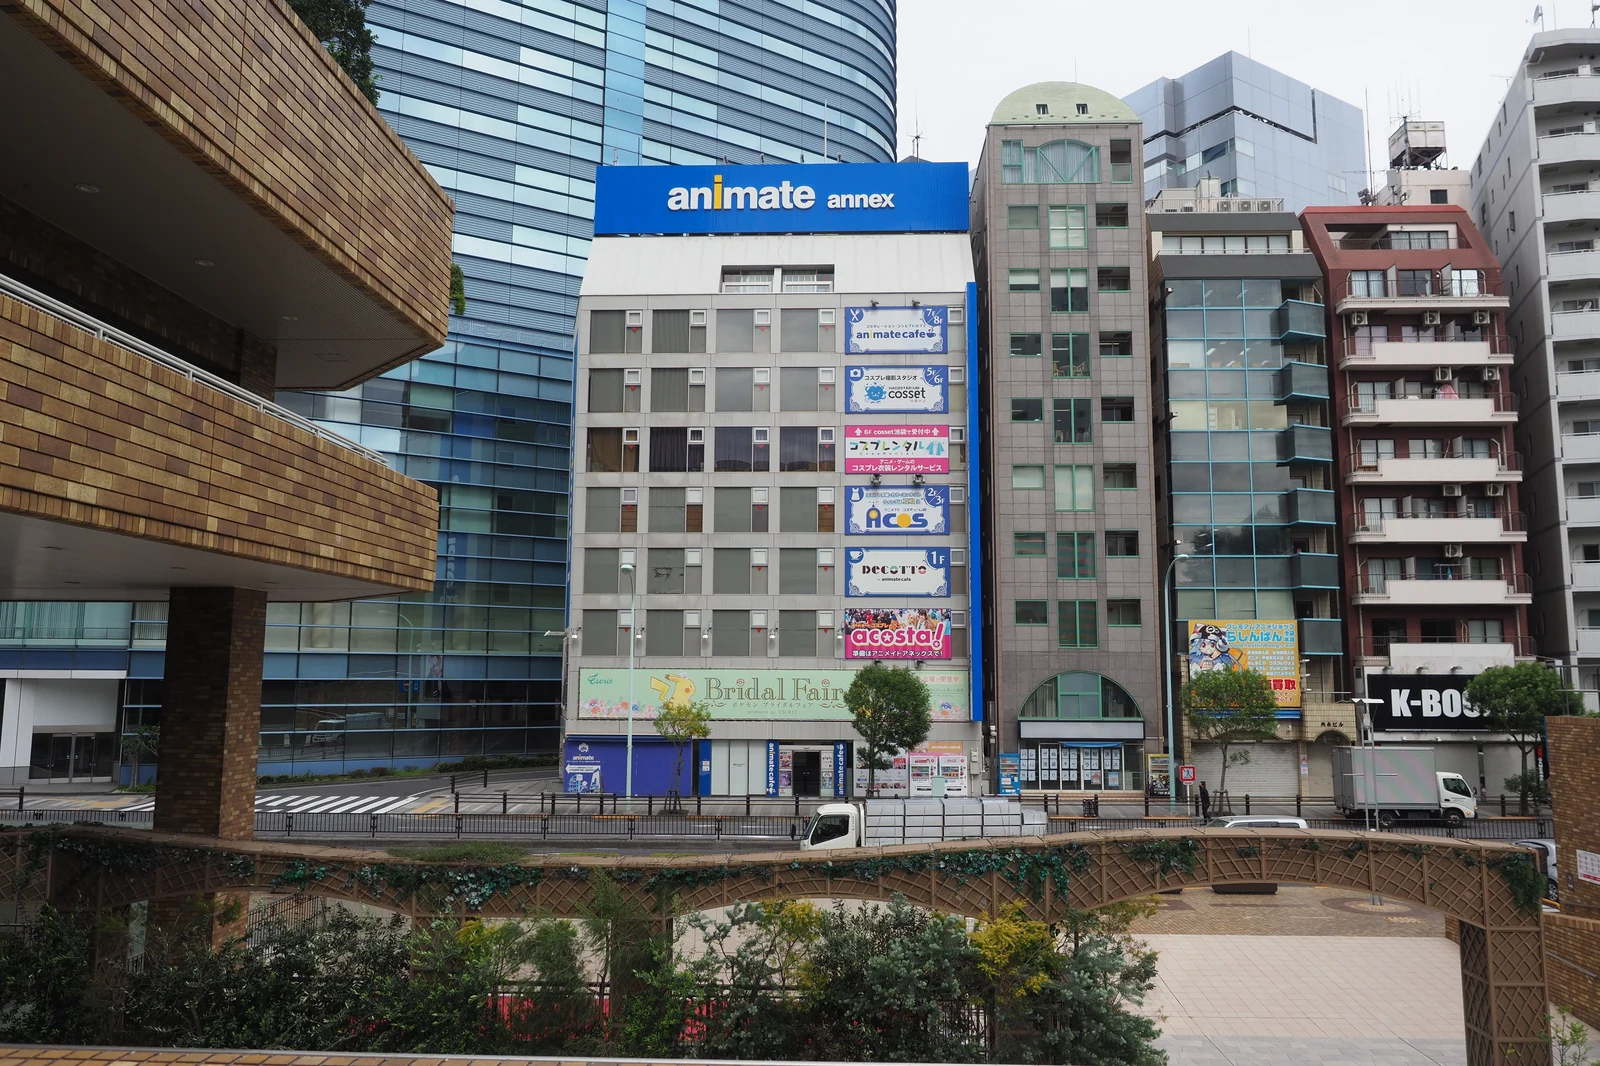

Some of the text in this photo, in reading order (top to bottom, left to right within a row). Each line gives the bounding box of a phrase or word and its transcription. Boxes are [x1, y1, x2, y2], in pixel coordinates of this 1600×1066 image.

[667, 174, 895, 211] animate annex
[927, 368, 936, 376] 5F
[934, 375, 943, 384] 6F
[888, 387, 926, 399] cosset
[852, 464, 942, 472] コスプレ衣装レンタルサービス
[927, 488, 937, 496] 2F
[936, 496, 945, 504] 3F
[931, 550, 945, 564] 1F
[851, 622, 945, 650] acosta!
[1226, 631, 1283, 642] らしんばん
[704, 677, 845, 701] Bridal Fair
[1390, 688, 1490, 717] K-BOO
